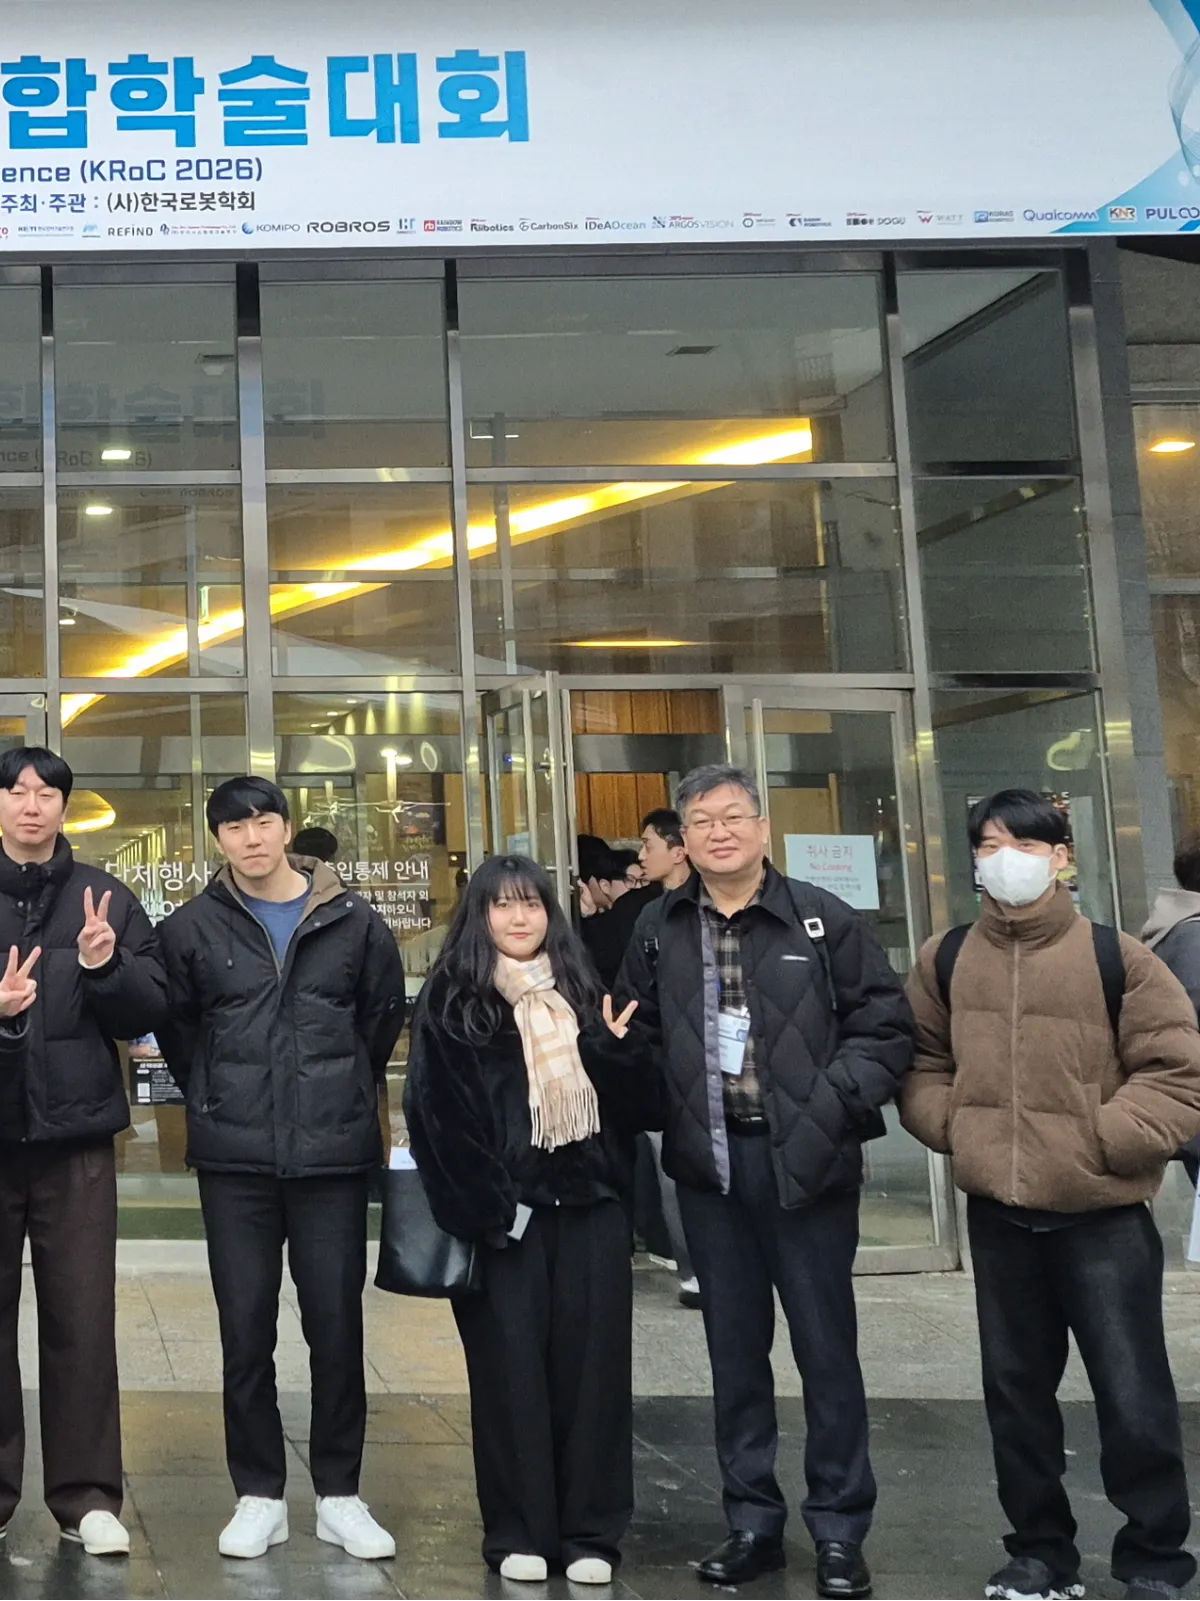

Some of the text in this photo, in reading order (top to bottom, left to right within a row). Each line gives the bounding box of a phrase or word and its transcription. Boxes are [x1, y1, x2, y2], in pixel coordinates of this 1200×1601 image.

[79, 158, 167, 184] (KRoC
[175, 157, 263, 184] 2026)
[0, 193, 87, 214] 주최·주관
[107, 190, 256, 213] (사)한국로봇학회
[1022, 208, 1099, 222] Qualcomm
[256, 223, 301, 232] KOMIPO
[306, 220, 391, 233] ROBROS
[530, 221, 579, 231] CarbonSix
[394, 860, 430, 881] 안내
[374, 889, 385, 902] 및
[387, 890, 416, 902] 참석자
[419, 890, 430, 902] 외
